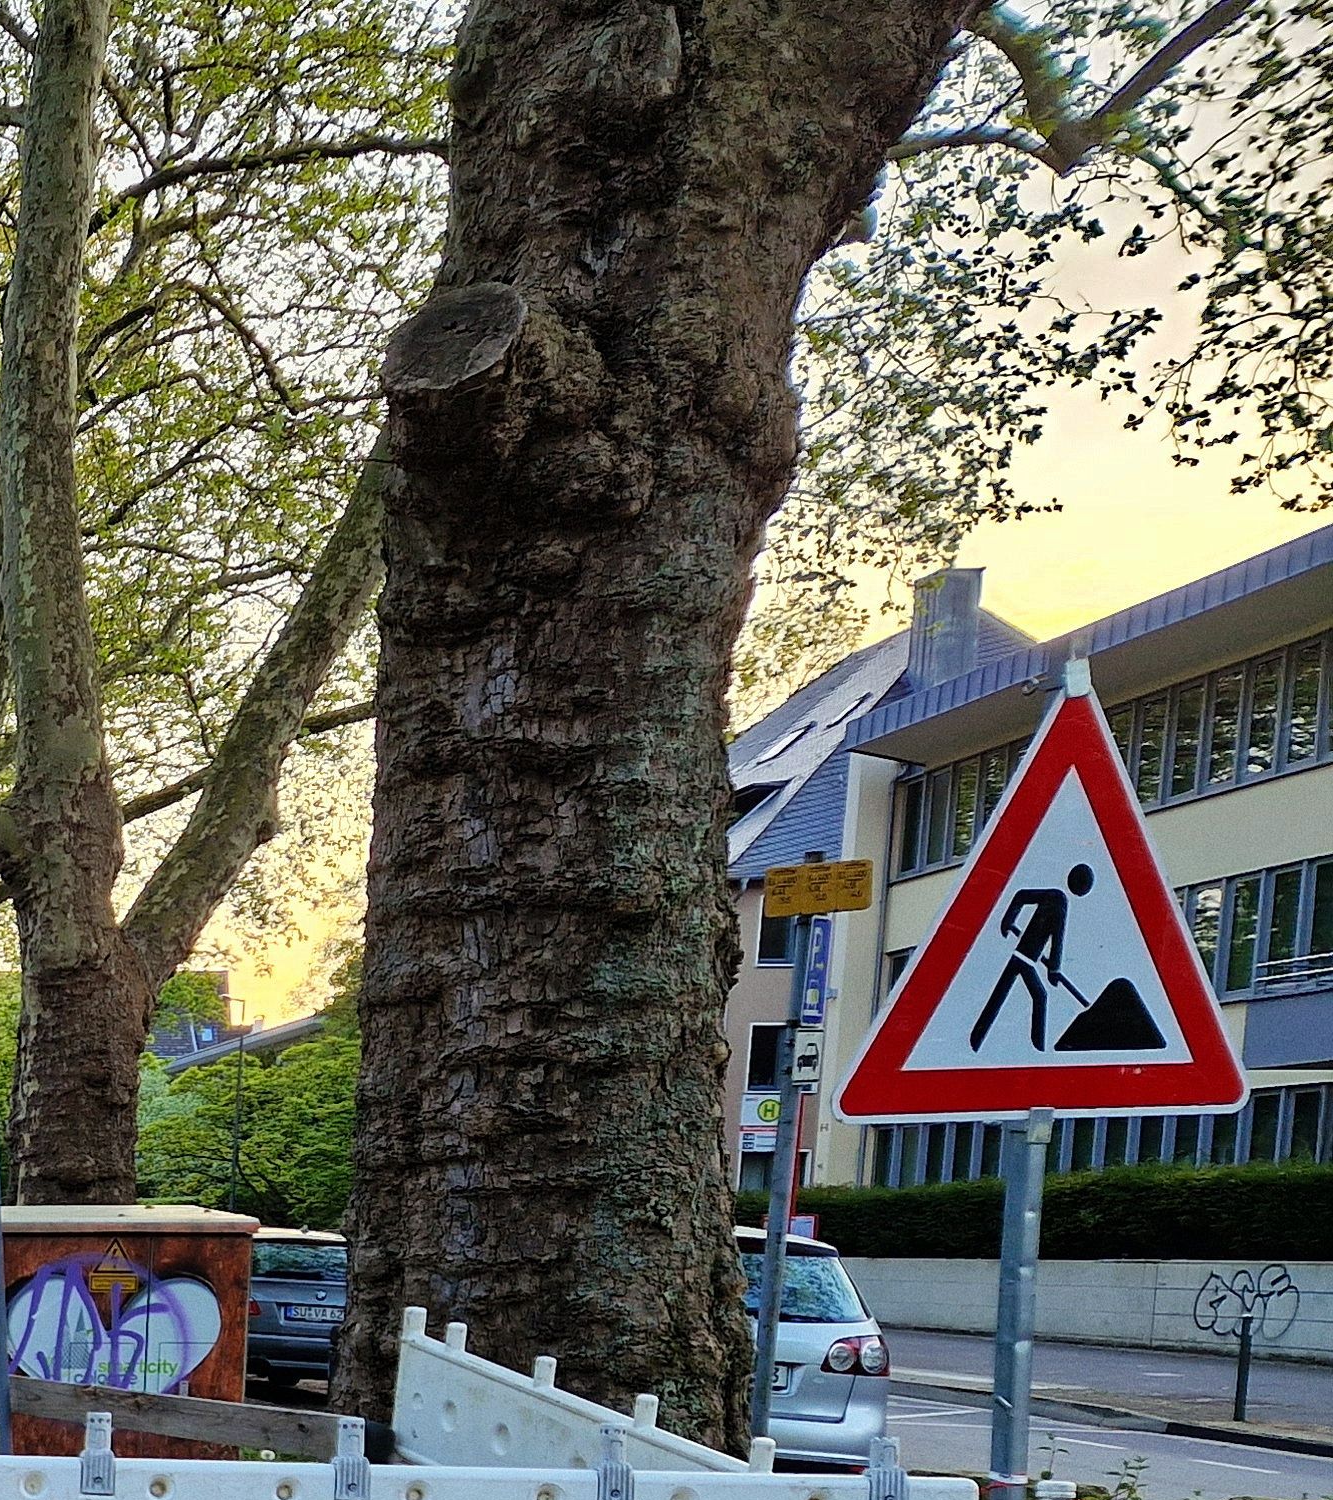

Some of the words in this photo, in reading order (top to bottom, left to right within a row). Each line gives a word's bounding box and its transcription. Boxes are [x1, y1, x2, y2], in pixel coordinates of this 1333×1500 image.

[763, 1103, 775, 1118] H
[293, 1306, 308, 1317] SU
[314, 1308, 328, 1318] VA
